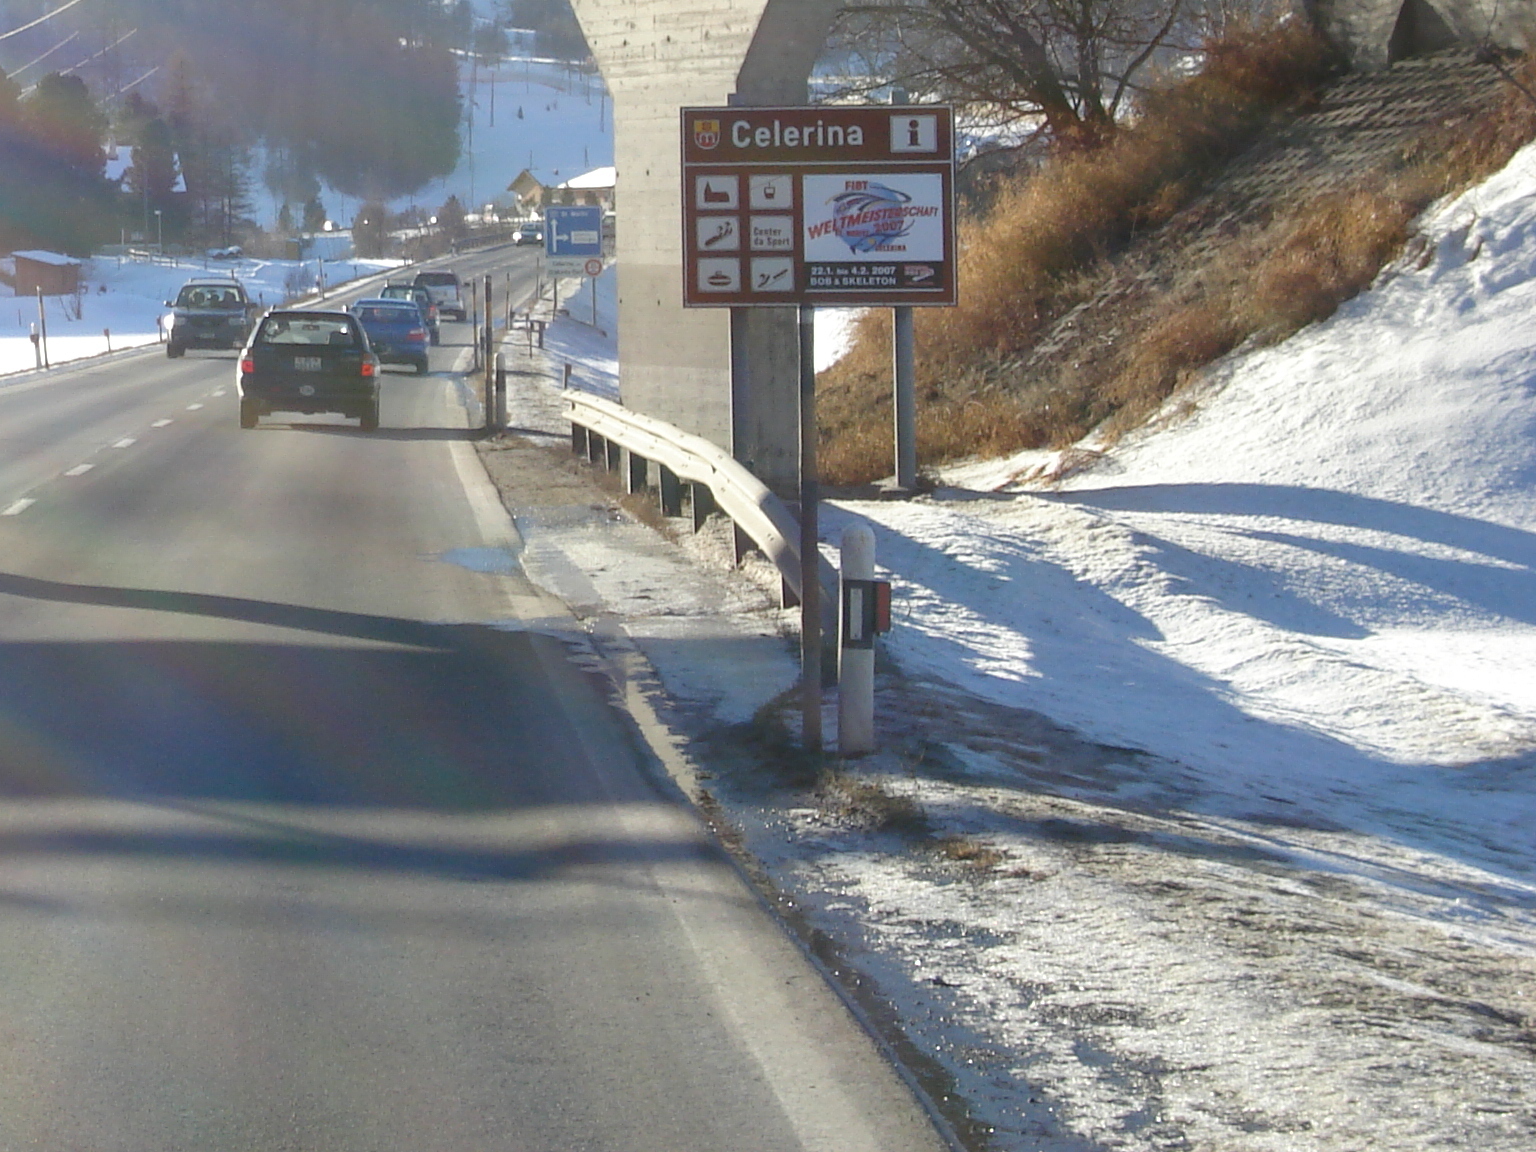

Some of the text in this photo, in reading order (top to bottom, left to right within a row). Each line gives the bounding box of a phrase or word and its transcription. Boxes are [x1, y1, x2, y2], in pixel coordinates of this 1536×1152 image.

[731, 119, 864, 148] Celerina
[845, 180, 868, 191] FIBT
[808, 206, 939, 240] WELTMEISTERSCHAFT
[873, 220, 904, 233] 2007
[753, 227, 782, 236] Center
[753, 237, 790, 248] da Sport
[811, 266, 834, 275] 22.1.
[851, 266, 870, 275] 4.2.
[871, 266, 896, 275] 2007
[810, 277, 832, 285] BOB
[842, 276, 896, 285] SKELETON
